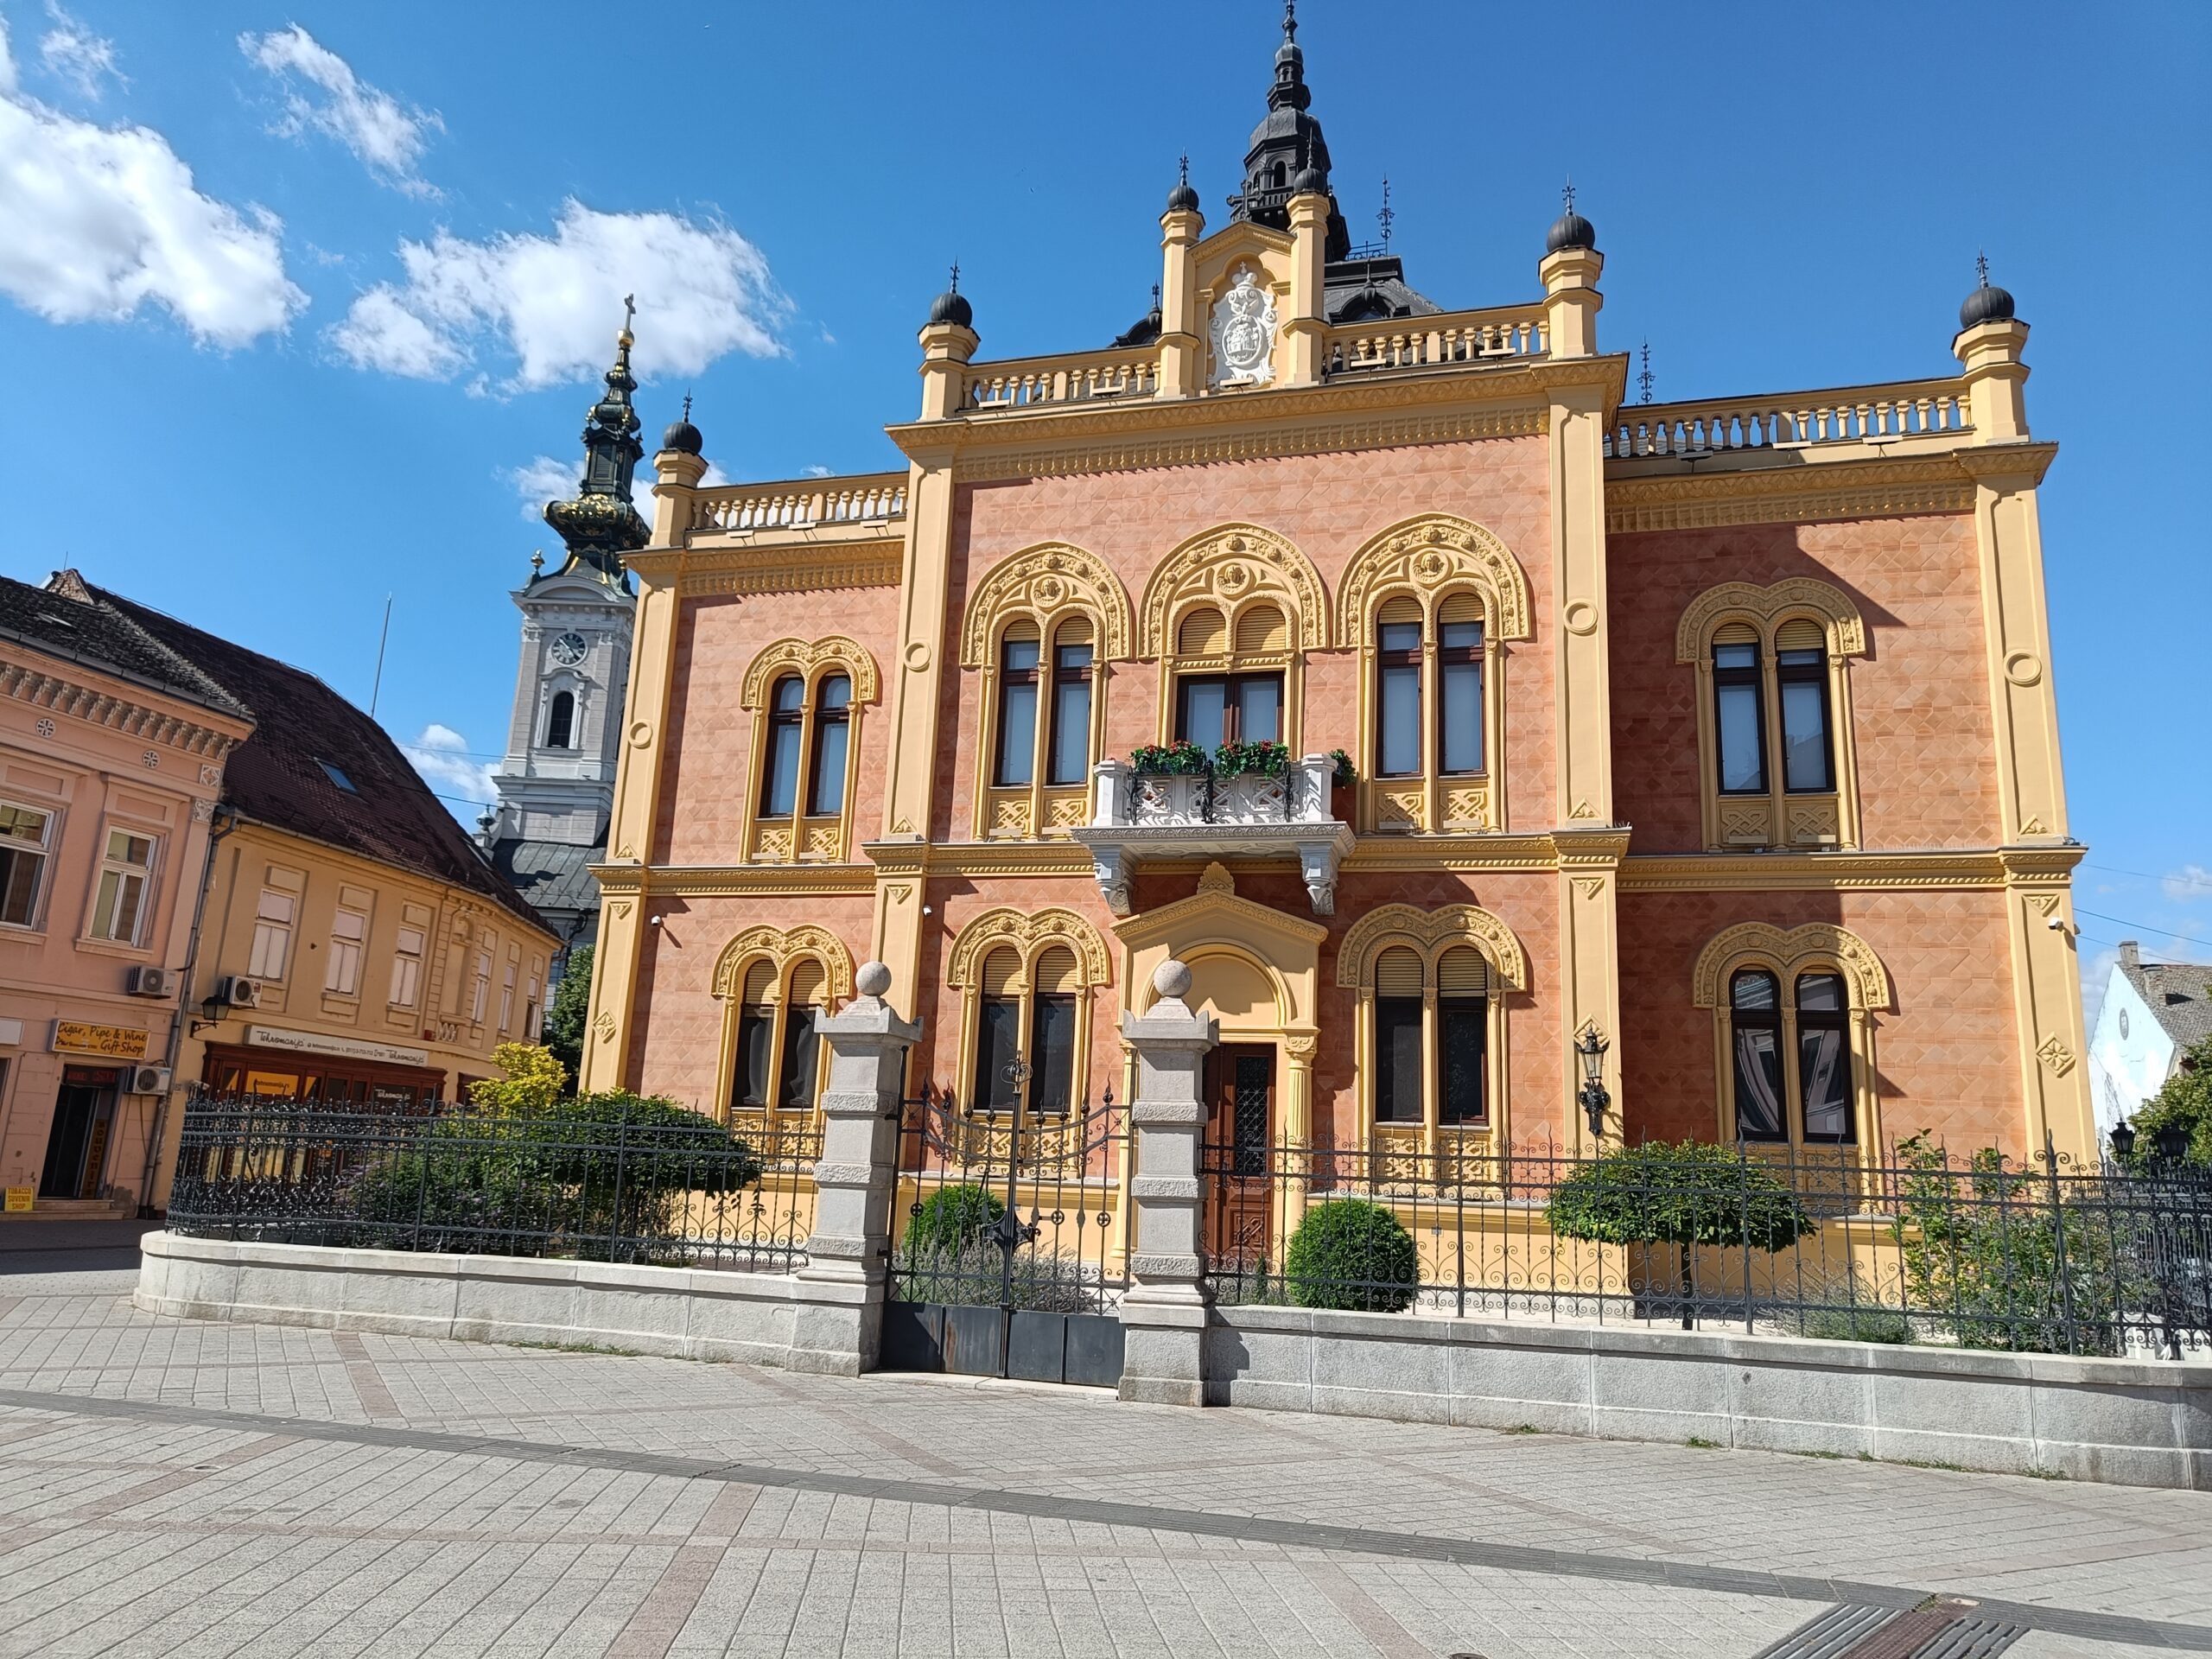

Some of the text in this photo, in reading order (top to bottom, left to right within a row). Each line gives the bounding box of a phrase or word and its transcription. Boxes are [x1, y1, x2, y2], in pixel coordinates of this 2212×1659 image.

[58, 1022, 147, 1042] Cigar, Pipe & Wine
[100, 1039, 120, 1054] Gift
[121, 1042, 144, 1056] Shop
